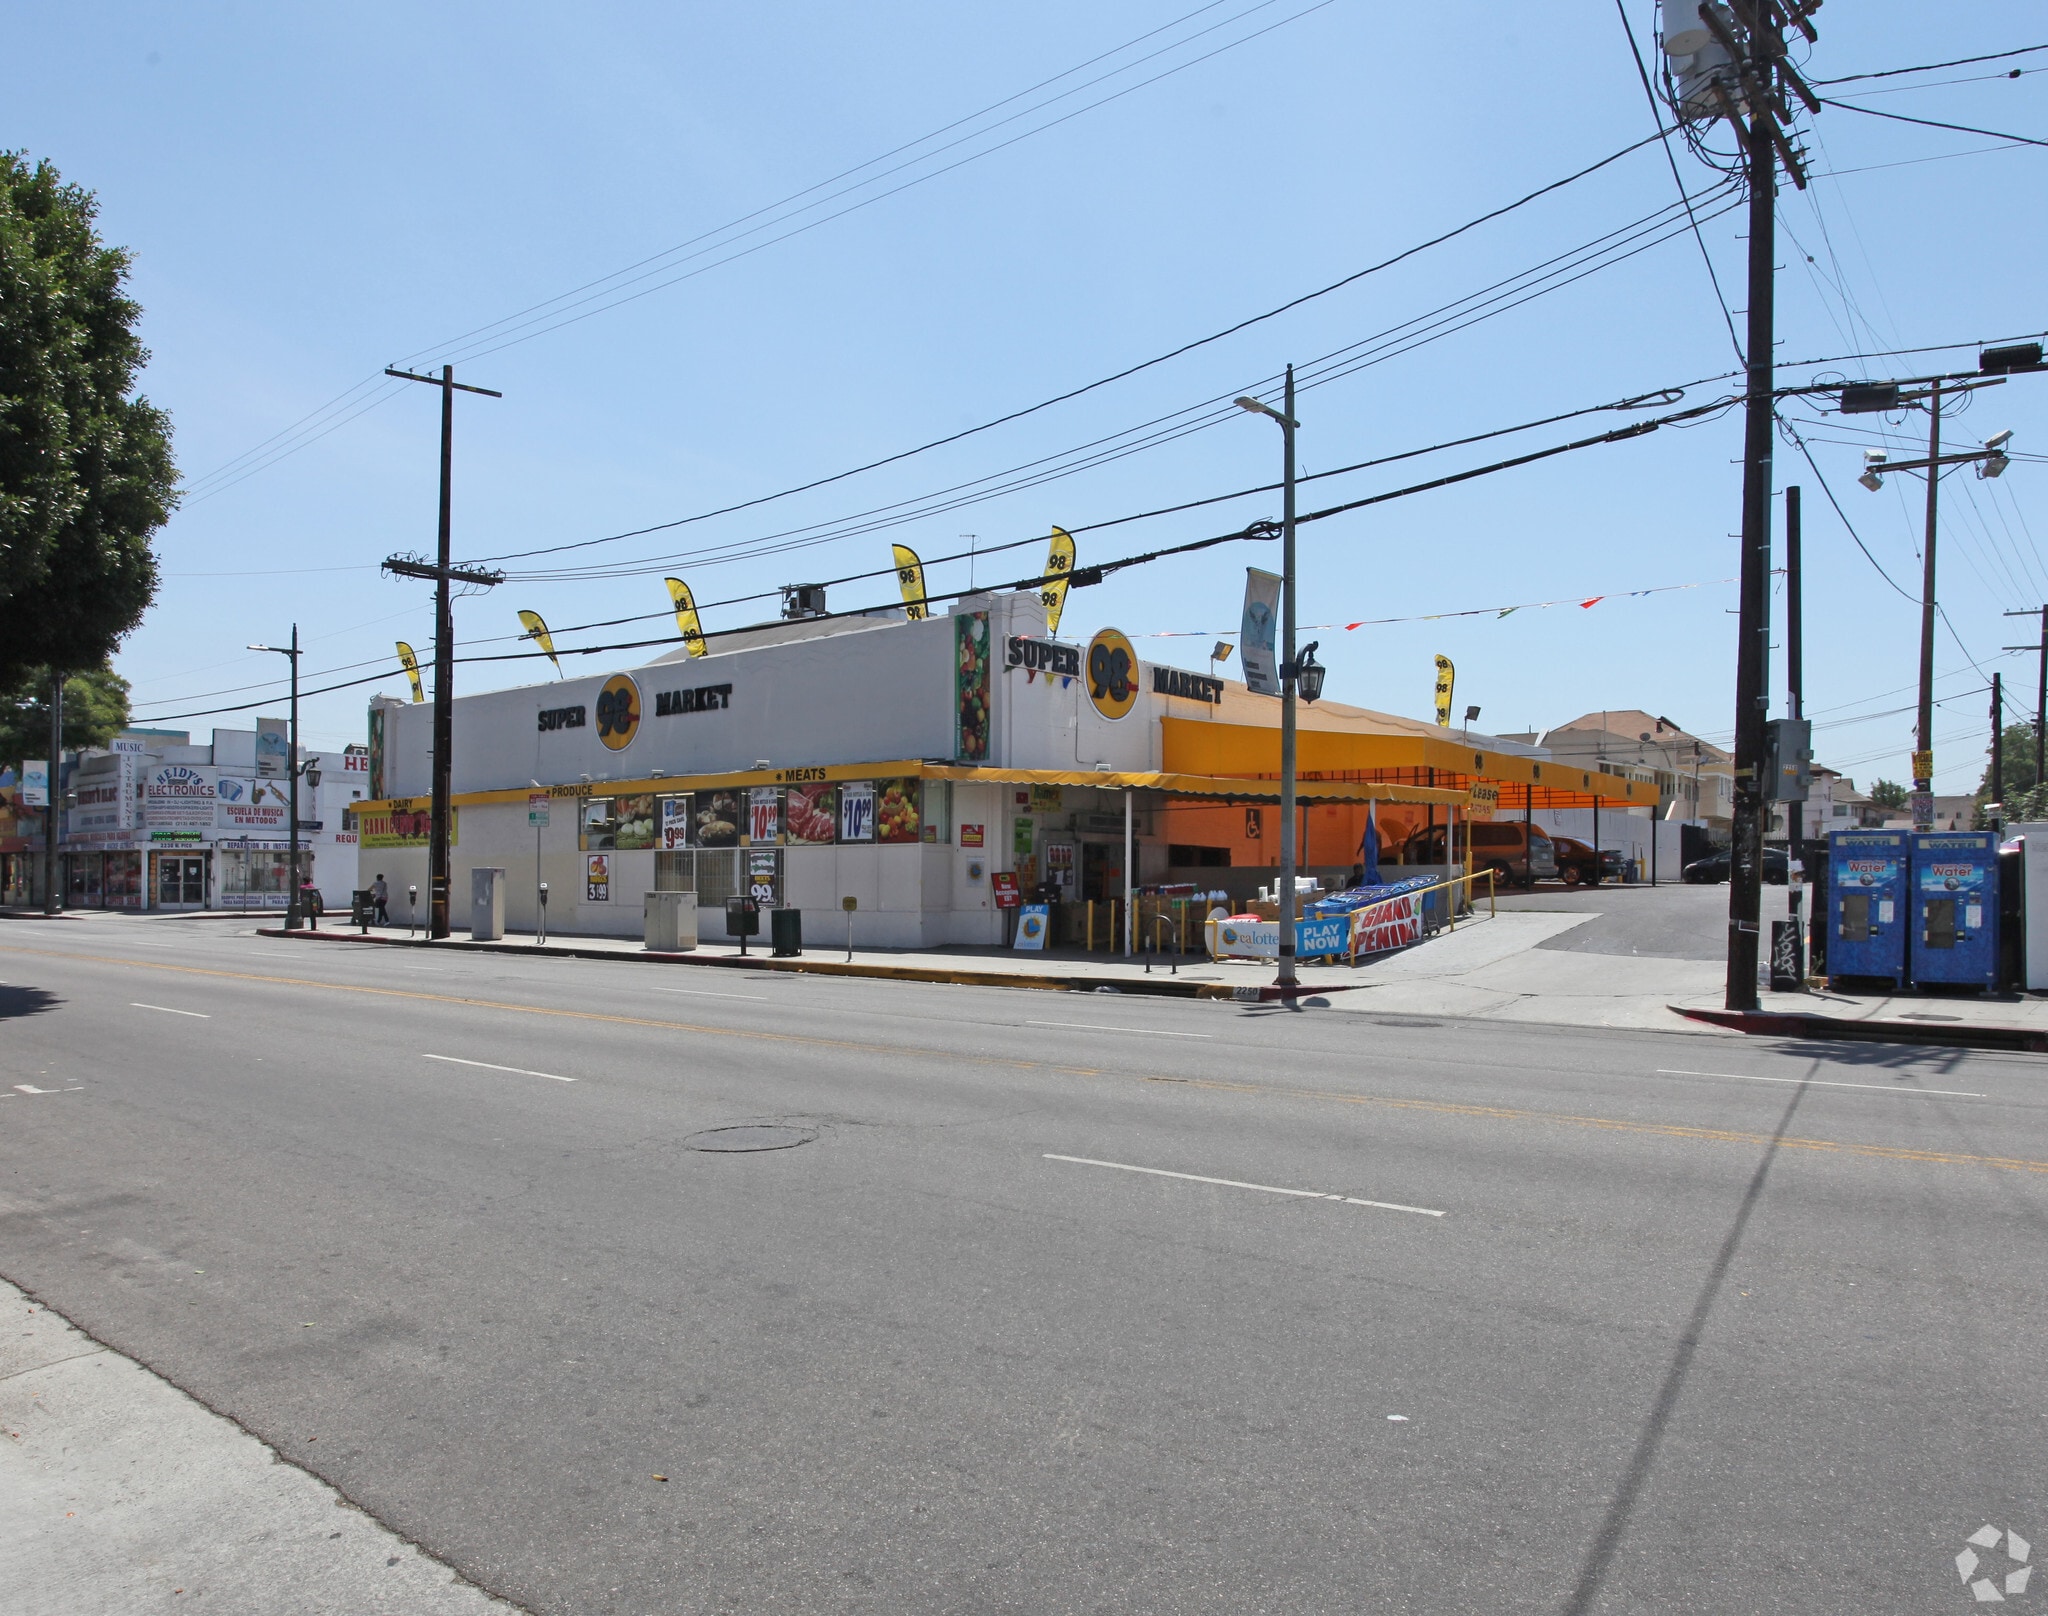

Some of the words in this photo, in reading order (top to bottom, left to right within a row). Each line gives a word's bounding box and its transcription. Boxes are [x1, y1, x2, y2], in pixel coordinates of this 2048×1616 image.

[1050, 555, 1066, 570] 98
[900, 568, 915, 584] 98
[675, 598, 688, 611] 98
[1042, 592, 1057, 606] 98
[1009, 637, 1080, 676] SUPER
[1091, 644, 1131, 702] 98
[1153, 667, 1224, 704] MARKET
[1437, 660, 1448, 669] 98
[1436, 684, 1448, 693] 98
[538, 706, 586, 731] SUPER
[598, 688, 633, 736] 98
[655, 684, 732, 717] MARKET
[115, 742, 143, 752] MUSIC
[156, 767, 203, 785] HEIDY'S
[785, 768, 826, 781] MEATS
[125, 756, 134, 828] INSTRUMENTS
[148, 785, 215, 796] ELECTRONICS
[552, 785, 593, 797] PRODUCE
[1473, 784, 1498, 800] Lease
[393, 799, 413, 808] DAIRY
[227, 807, 252, 815] ESCUELA
[253, 808, 261, 816] DE
[262, 808, 283, 817] MUSICA
[235, 816, 243, 824] EN
[336, 835, 357, 843] REQU
[1849, 863, 1886, 872] Water
[1932, 867, 1972, 877] Water
[751, 884, 772, 902] 99
[1025, 905, 1043, 913] PLAY
[1304, 924, 1339, 938] PLAY
[1304, 935, 1340, 951] NOW
[1237, 986, 1258, 995] 2250
